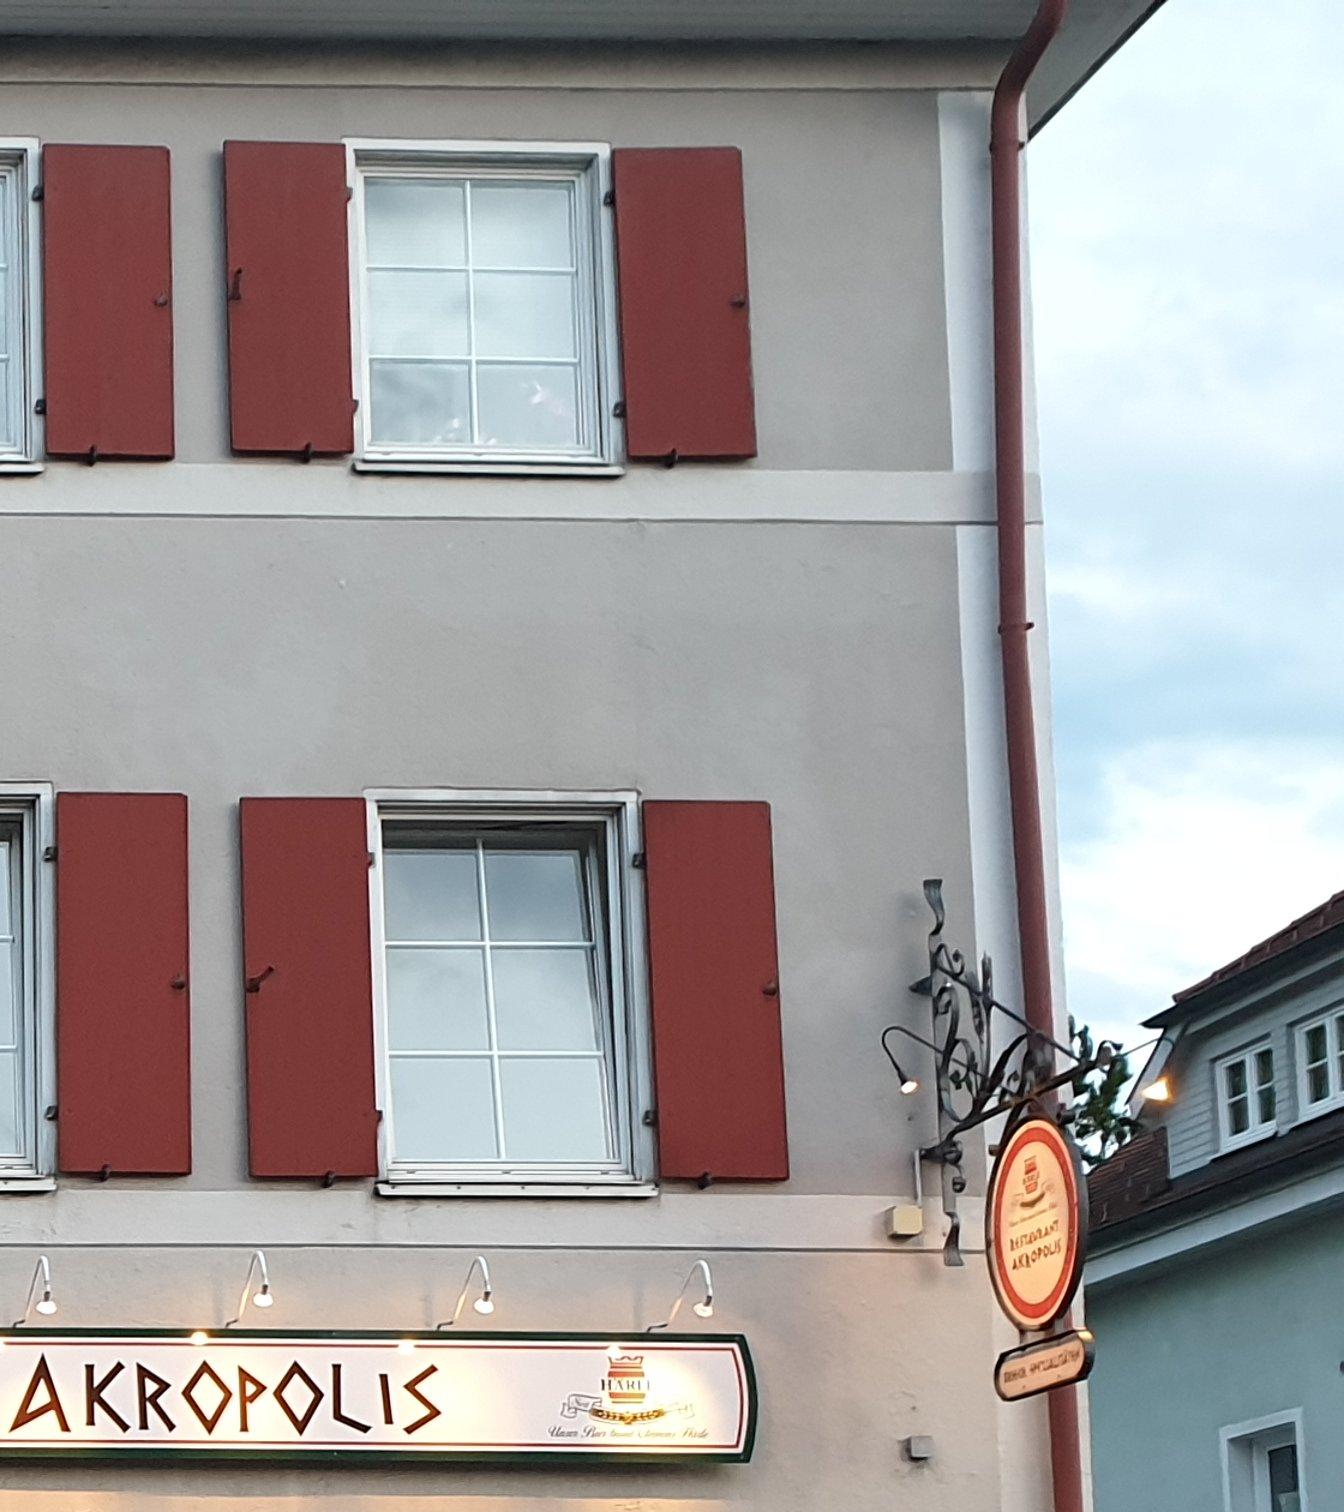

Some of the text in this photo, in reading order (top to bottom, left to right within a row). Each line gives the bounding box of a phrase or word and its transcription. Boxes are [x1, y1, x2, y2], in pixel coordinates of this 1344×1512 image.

[1010, 1219, 1059, 1252] RESTAURANT
[1012, 1238, 1062, 1270] AKROPOLIS
[8, 1352, 442, 1437] AKROPOLIS
